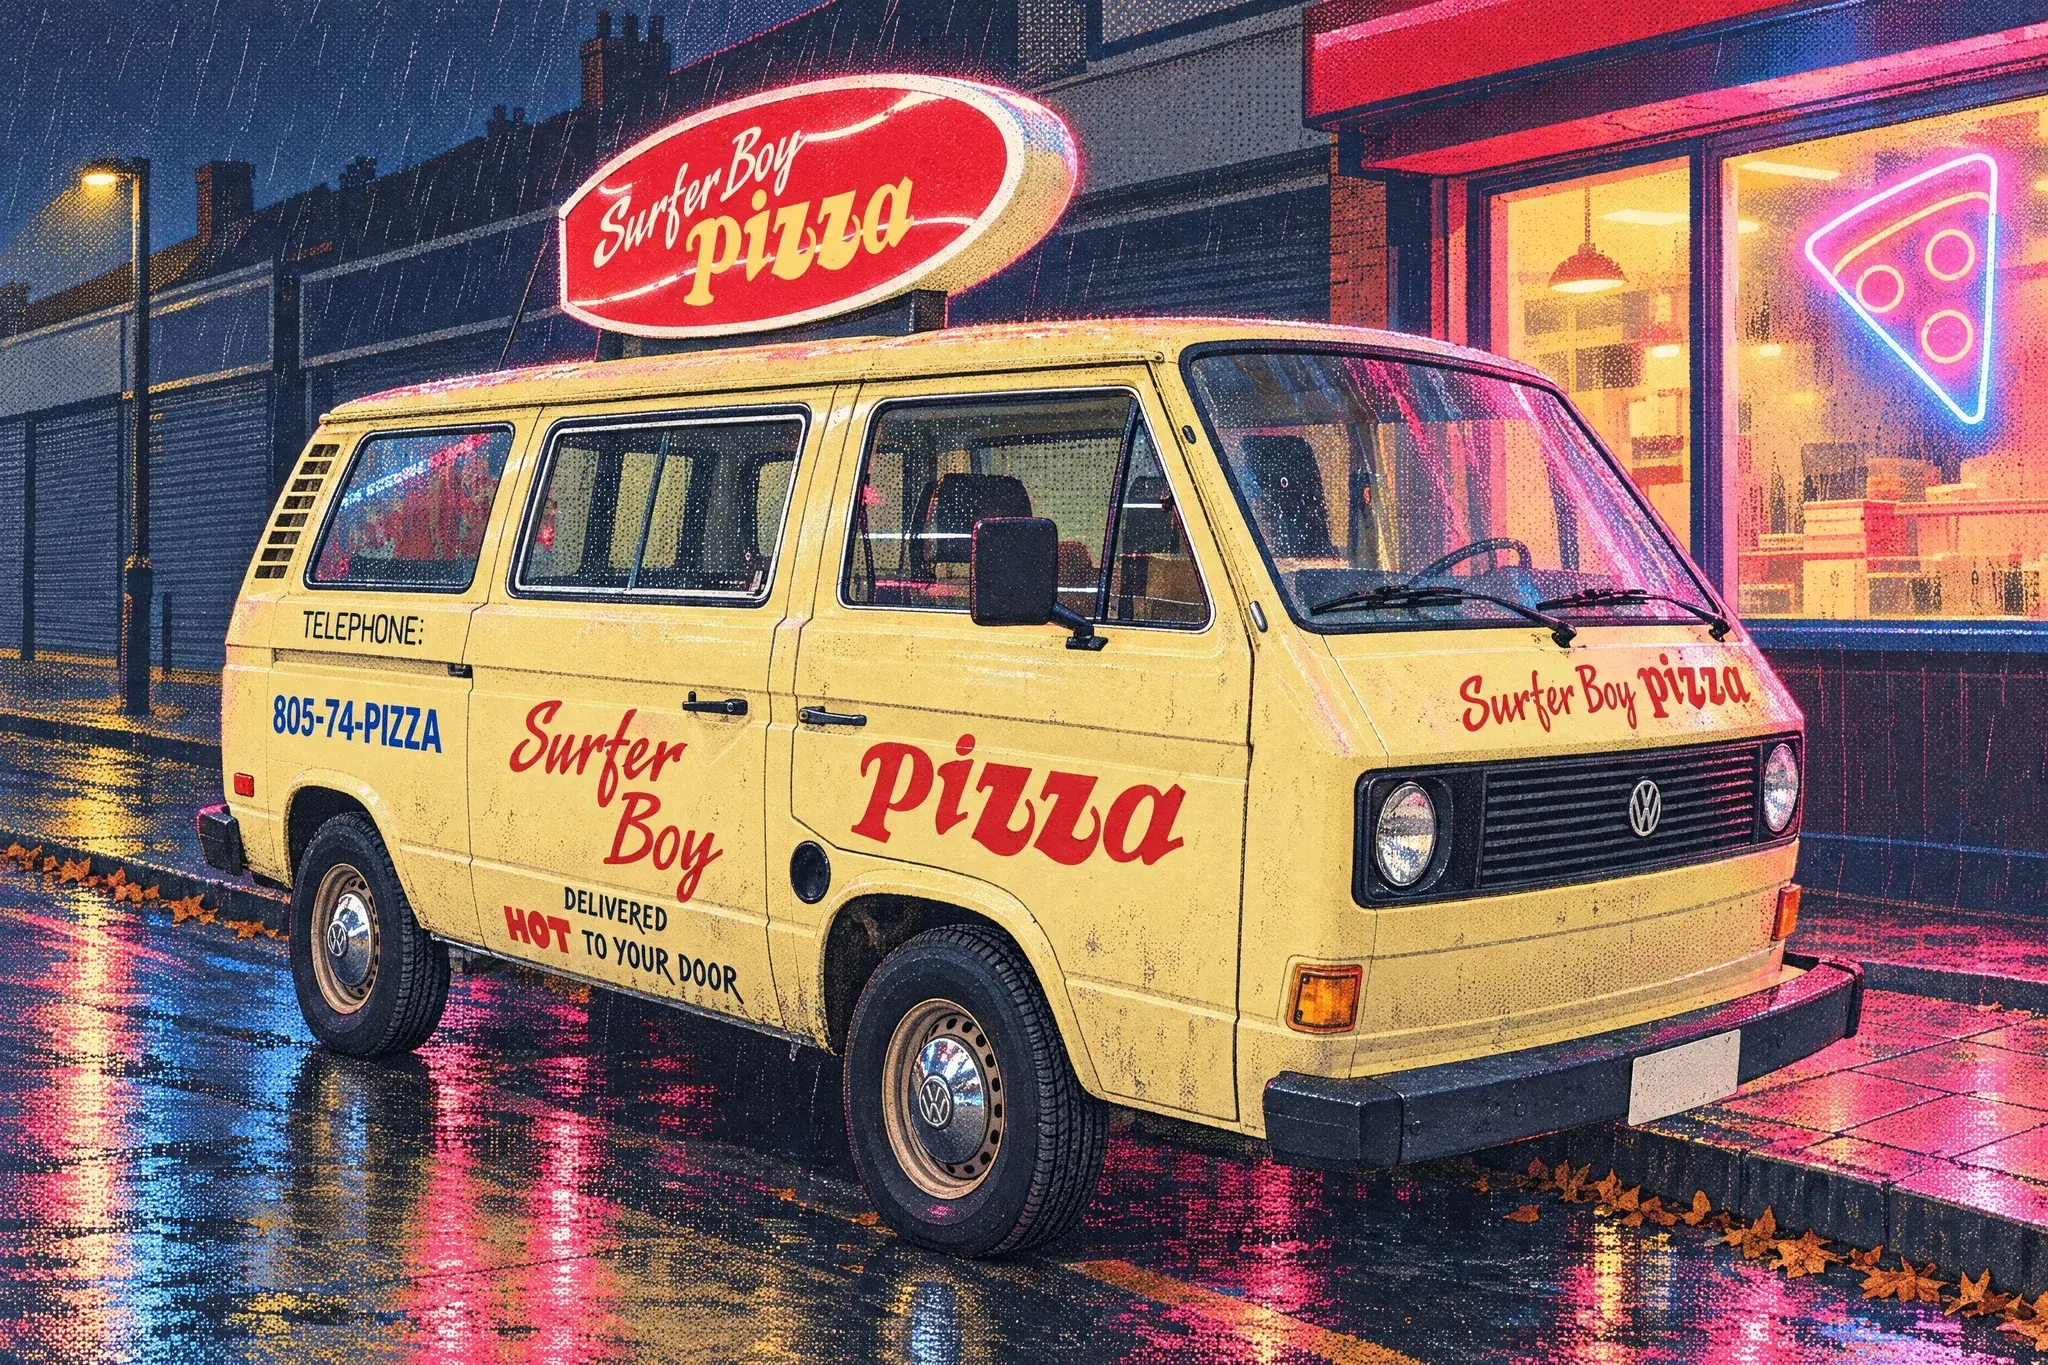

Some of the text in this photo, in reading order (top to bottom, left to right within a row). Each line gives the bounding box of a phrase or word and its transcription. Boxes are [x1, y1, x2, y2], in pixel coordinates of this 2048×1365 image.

[593, 126, 807, 268] Surfer Boy
[683, 176, 915, 307] pizza
[272, 695, 442, 754] 805-74-PIZZA
[1459, 653, 1751, 732] Surfer Boy pizza
[509, 700, 687, 808] Surfer
[603, 792, 723, 903] Boy
[503, 906, 745, 1005] HOT TO YOUR DOOR
[564, 886, 668, 935] DELIVERED
